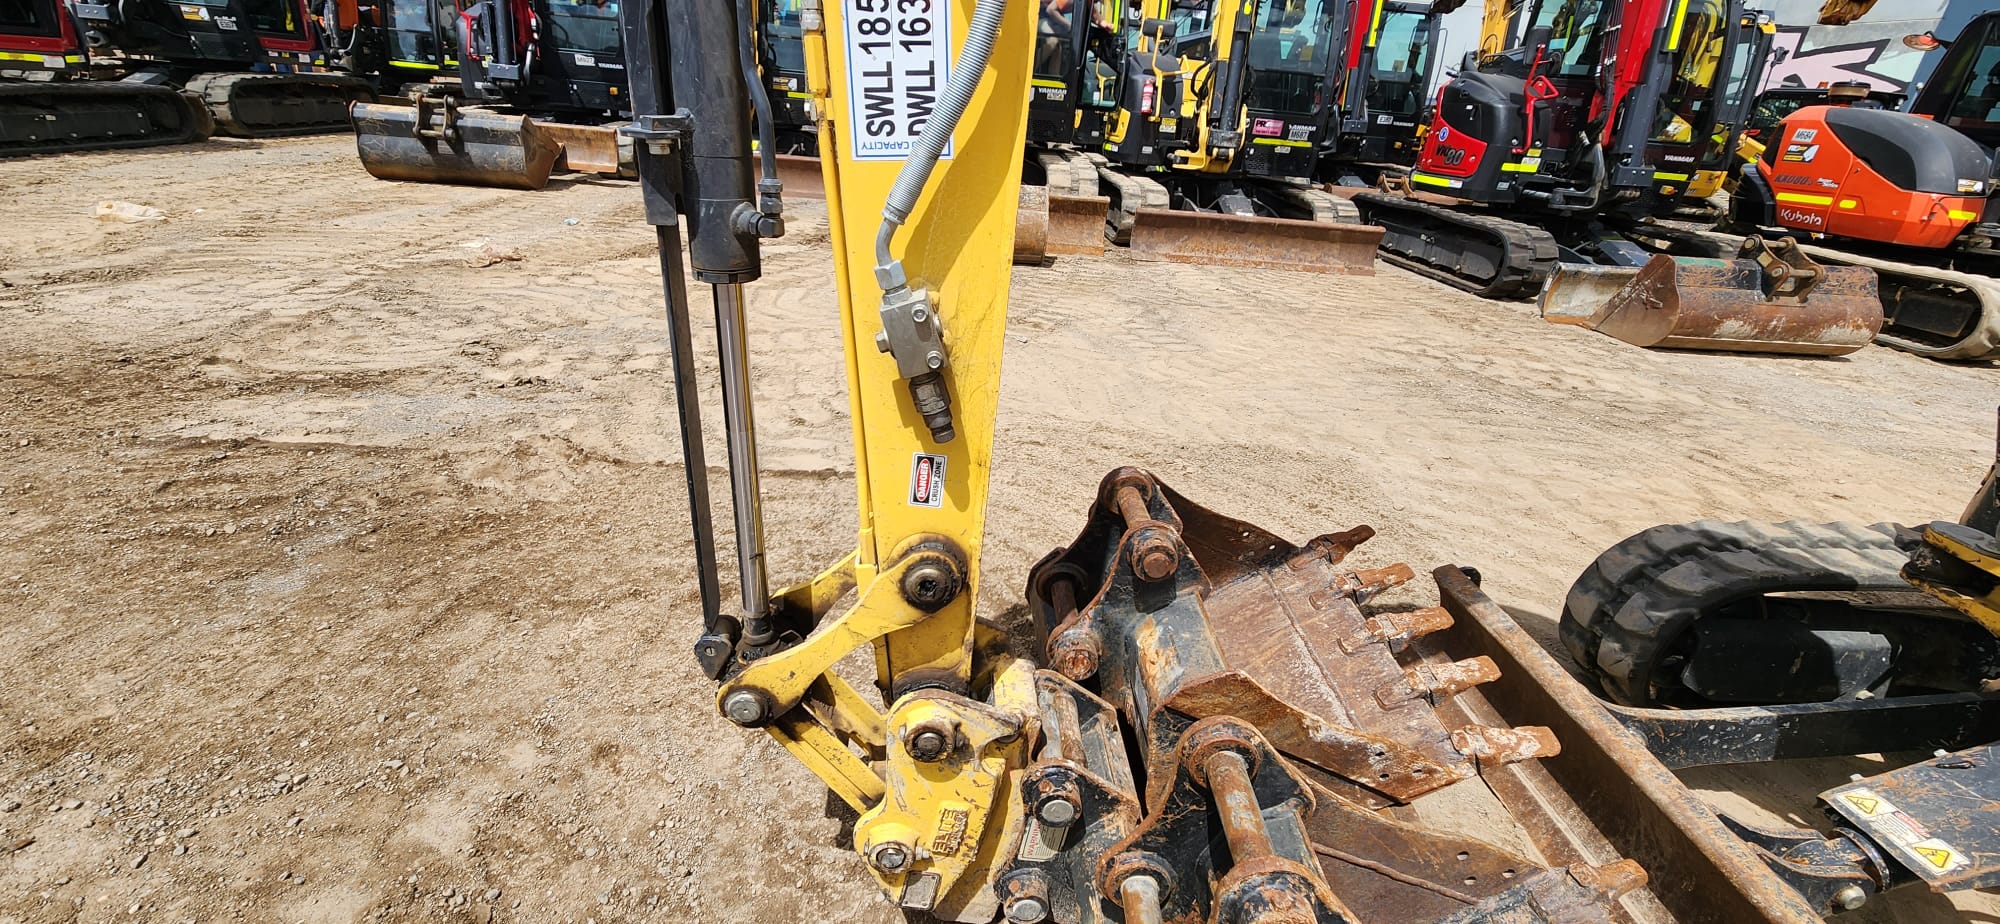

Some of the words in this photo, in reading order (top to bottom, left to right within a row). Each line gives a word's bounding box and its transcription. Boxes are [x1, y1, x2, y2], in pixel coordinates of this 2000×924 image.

[863, 61, 896, 137] SWLL
[905, 60, 936, 136] DWLL
[1038, 87, 1068, 95] YANMAR
[1288, 124, 1317, 132] YANMAR
[861, 141, 910, 150] CAPACITY
[1664, 154, 1696, 163] YANMAR
[1780, 208, 1822, 226] Kubota
[934, 460, 942, 479] ZONE
[918, 463, 929, 497] DANGER
[931, 481, 940, 502] CRUSH
